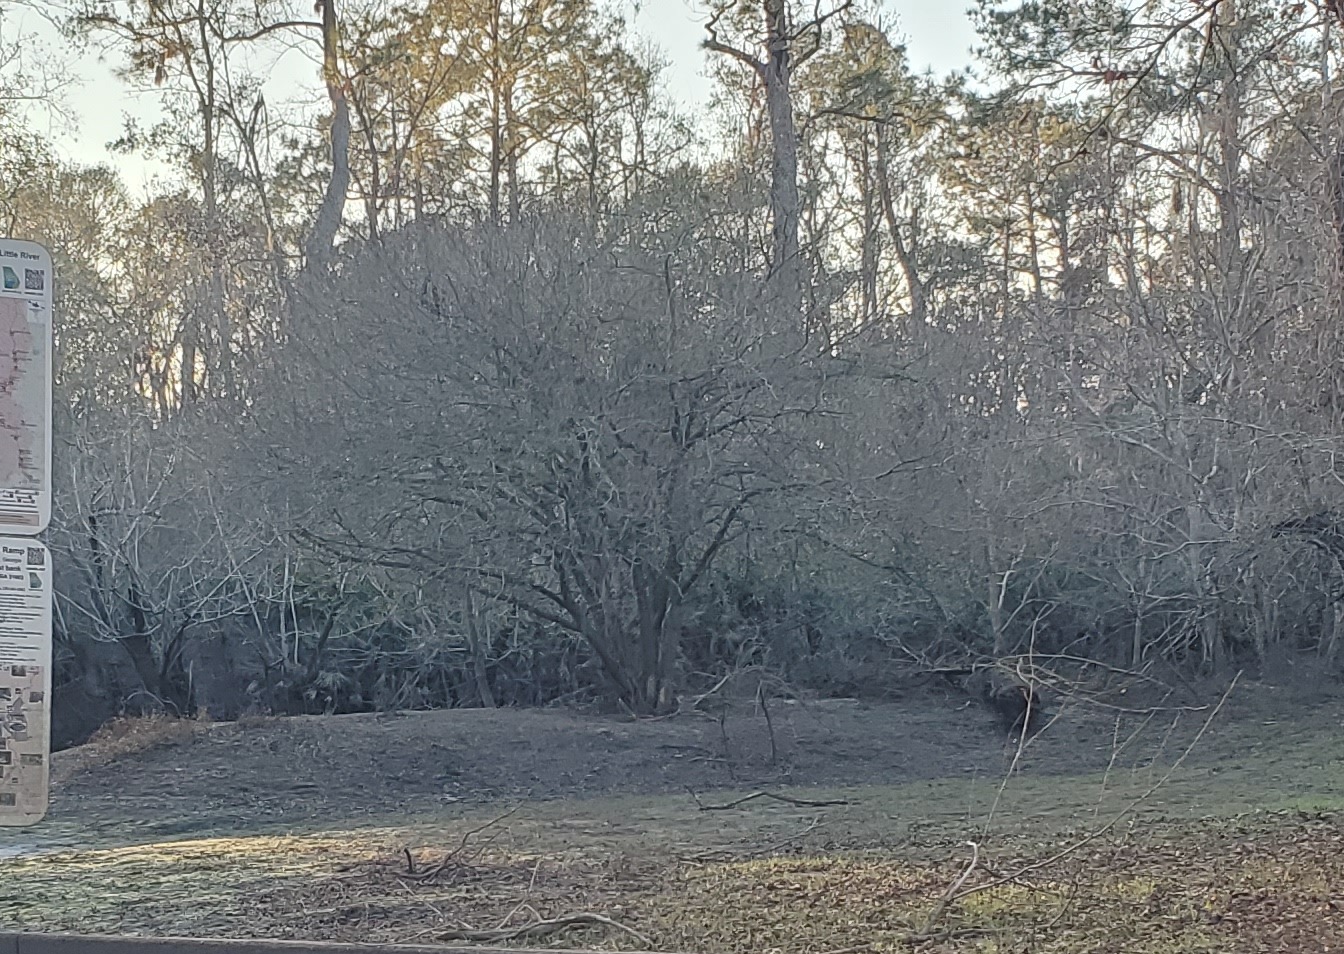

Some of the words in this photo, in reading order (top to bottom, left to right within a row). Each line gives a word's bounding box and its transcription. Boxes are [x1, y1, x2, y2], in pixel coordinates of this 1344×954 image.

[0, 249, 18, 259] Little
[20, 251, 40, 261] River
[2, 546, 25, 555] Ramp
